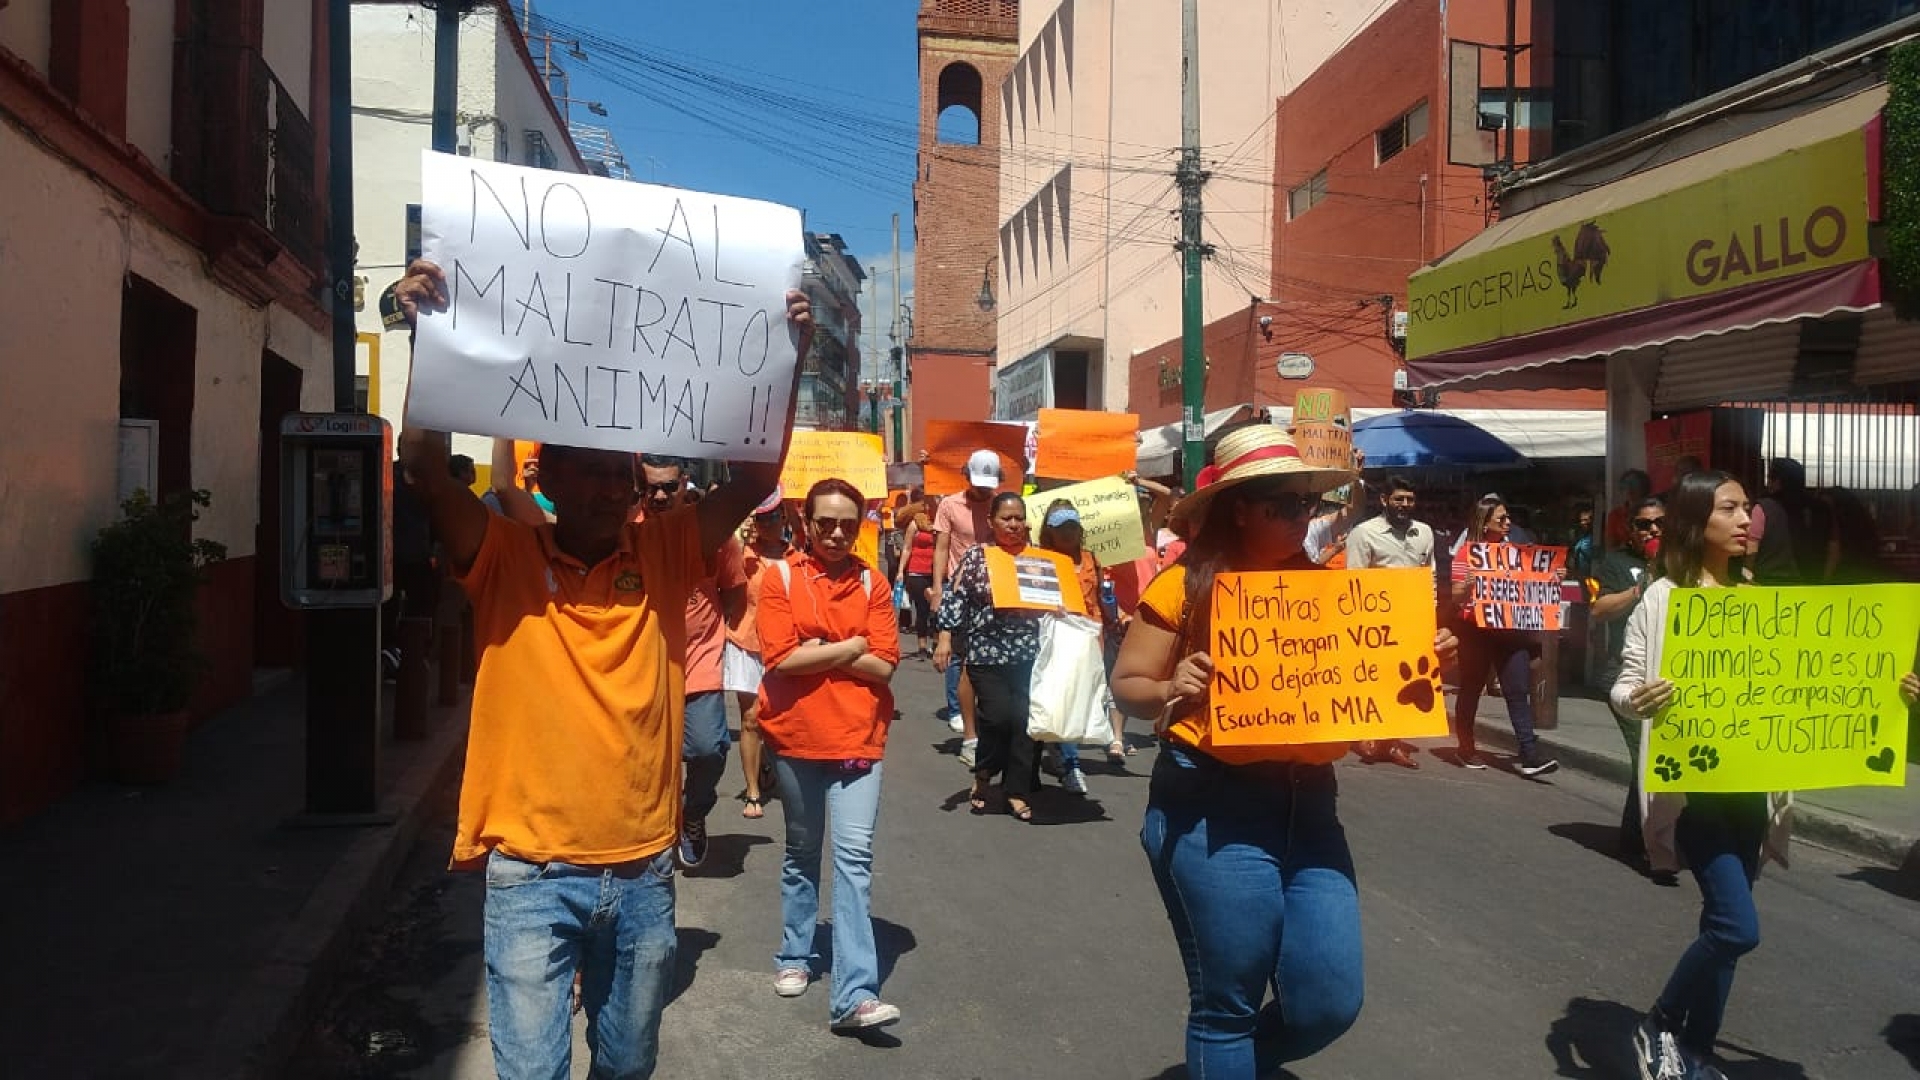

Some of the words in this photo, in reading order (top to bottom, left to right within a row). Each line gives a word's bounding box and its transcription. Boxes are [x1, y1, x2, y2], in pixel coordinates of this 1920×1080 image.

[470, 168, 590, 259] NO
[647, 197, 755, 288] AL
[1685, 205, 1847, 286] GALLO
[1410, 260, 1554, 325] ROSTICERIAS
[452, 258, 770, 377] MALTRATO
[500, 356, 727, 446] ANIMAL
[1297, 392, 1330, 420] NO
[1304, 445, 1350, 462] ANIMAL
[1507, 546, 1525, 571] LA
[1531, 549, 1557, 573] LEY
[1215, 575, 1320, 622] Mientras
[1337, 578, 1392, 617] ellos
[1475, 575, 1488, 600] DE
[1490, 577, 1519, 602] SERES
[1483, 602, 1504, 628] EN
[1673, 590, 1807, 640] ¡Defender
[1816, 602, 1834, 638] a
[1218, 627, 1260, 658] NO
[1265, 627, 1339, 671] tengan
[1347, 625, 1399, 649] VOZ
[1670, 644, 1782, 680] animales
[1796, 647, 1823, 681] no
[1830, 651, 1858, 677] es
[1865, 650, 1896, 682] un
[1216, 664, 1260, 696] NO
[1271, 663, 1342, 699] dejaras
[1353, 659, 1379, 684] de
[1668, 681, 1726, 709] acto
[1736, 680, 1766, 707] de
[1215, 704, 1296, 733] Escuchar
[1302, 701, 1320, 725] la
[1331, 695, 1384, 725] MIA
[1660, 713, 1717, 741] Sino
[1722, 708, 1750, 740] de
[1756, 712, 1880, 754] JUSTICIA!
